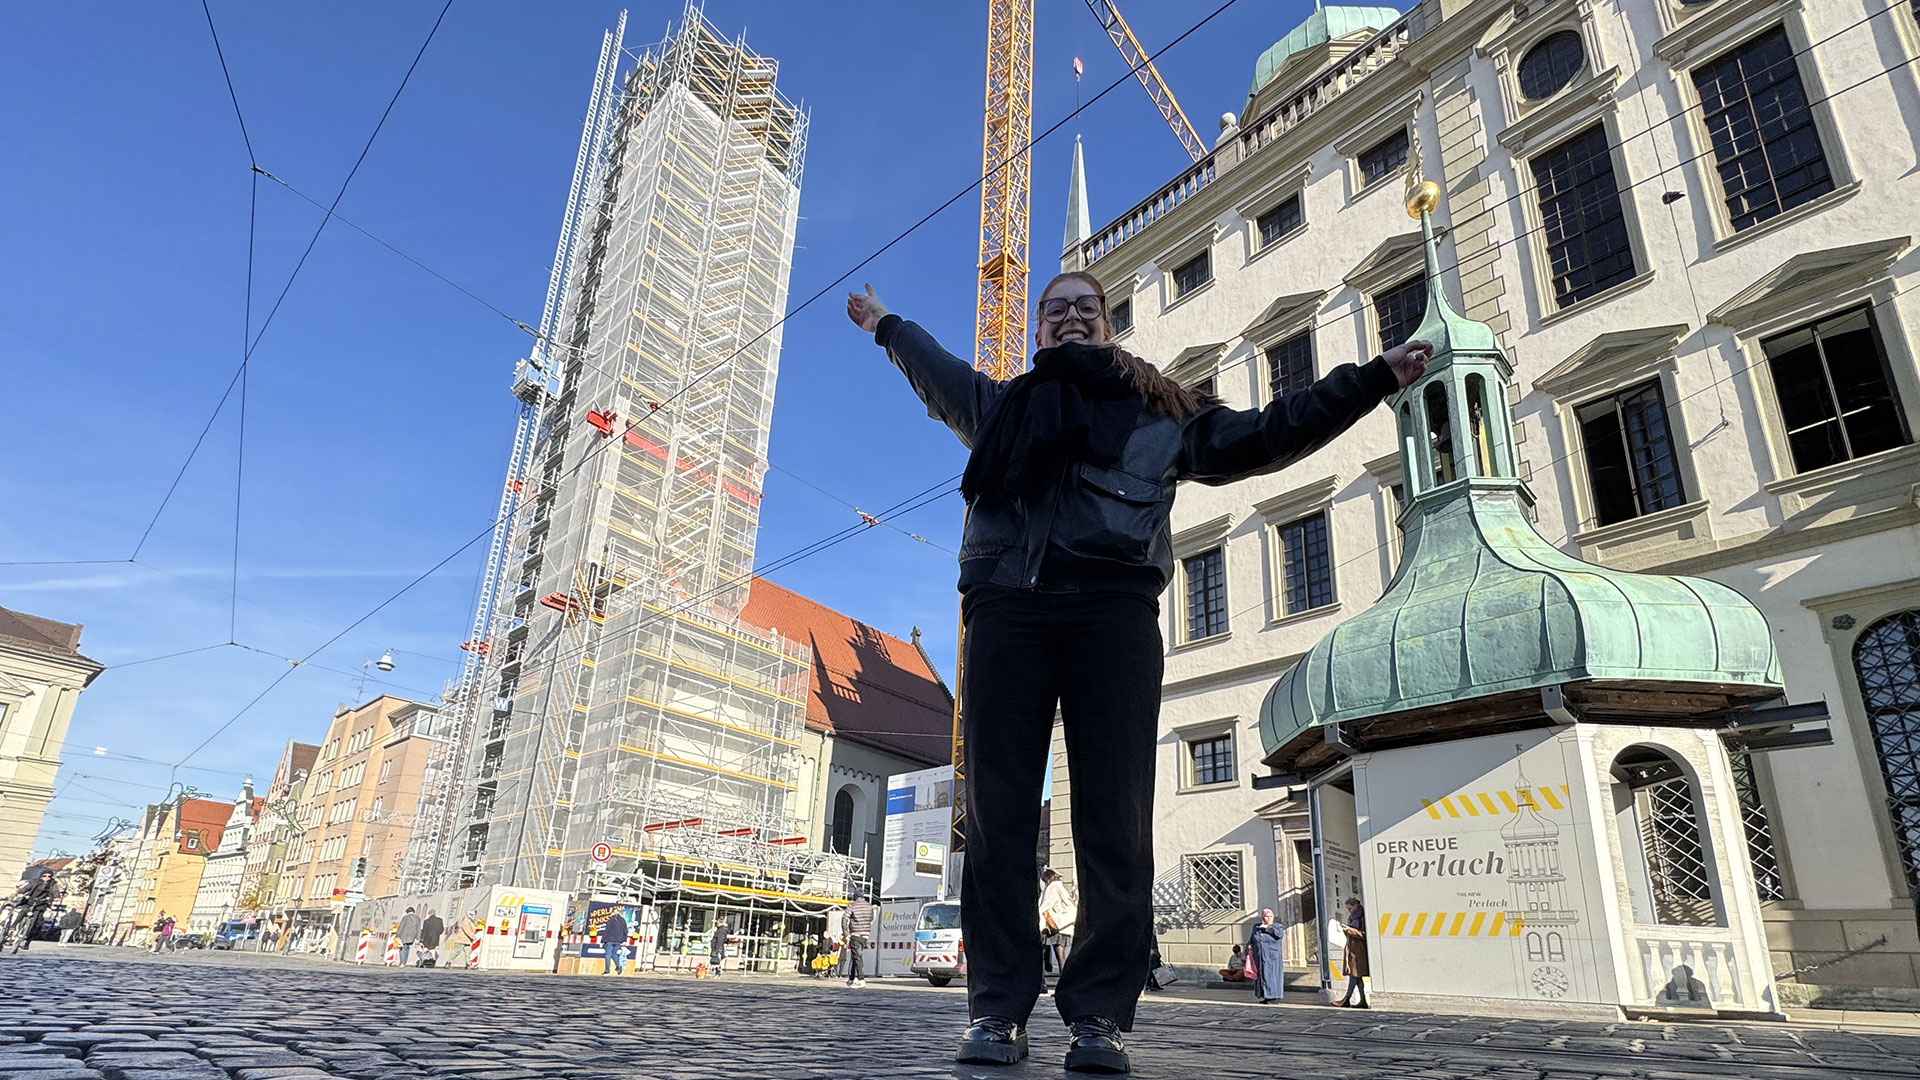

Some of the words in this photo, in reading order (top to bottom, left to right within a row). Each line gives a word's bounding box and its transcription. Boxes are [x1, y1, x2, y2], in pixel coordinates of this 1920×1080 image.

[1376, 840, 1408, 854] DER
[1412, 837, 1458, 853] NEUE
[1386, 851, 1506, 879] Perlach
[1468, 899, 1508, 908] Perlach
[892, 911, 917, 921] Perlach
